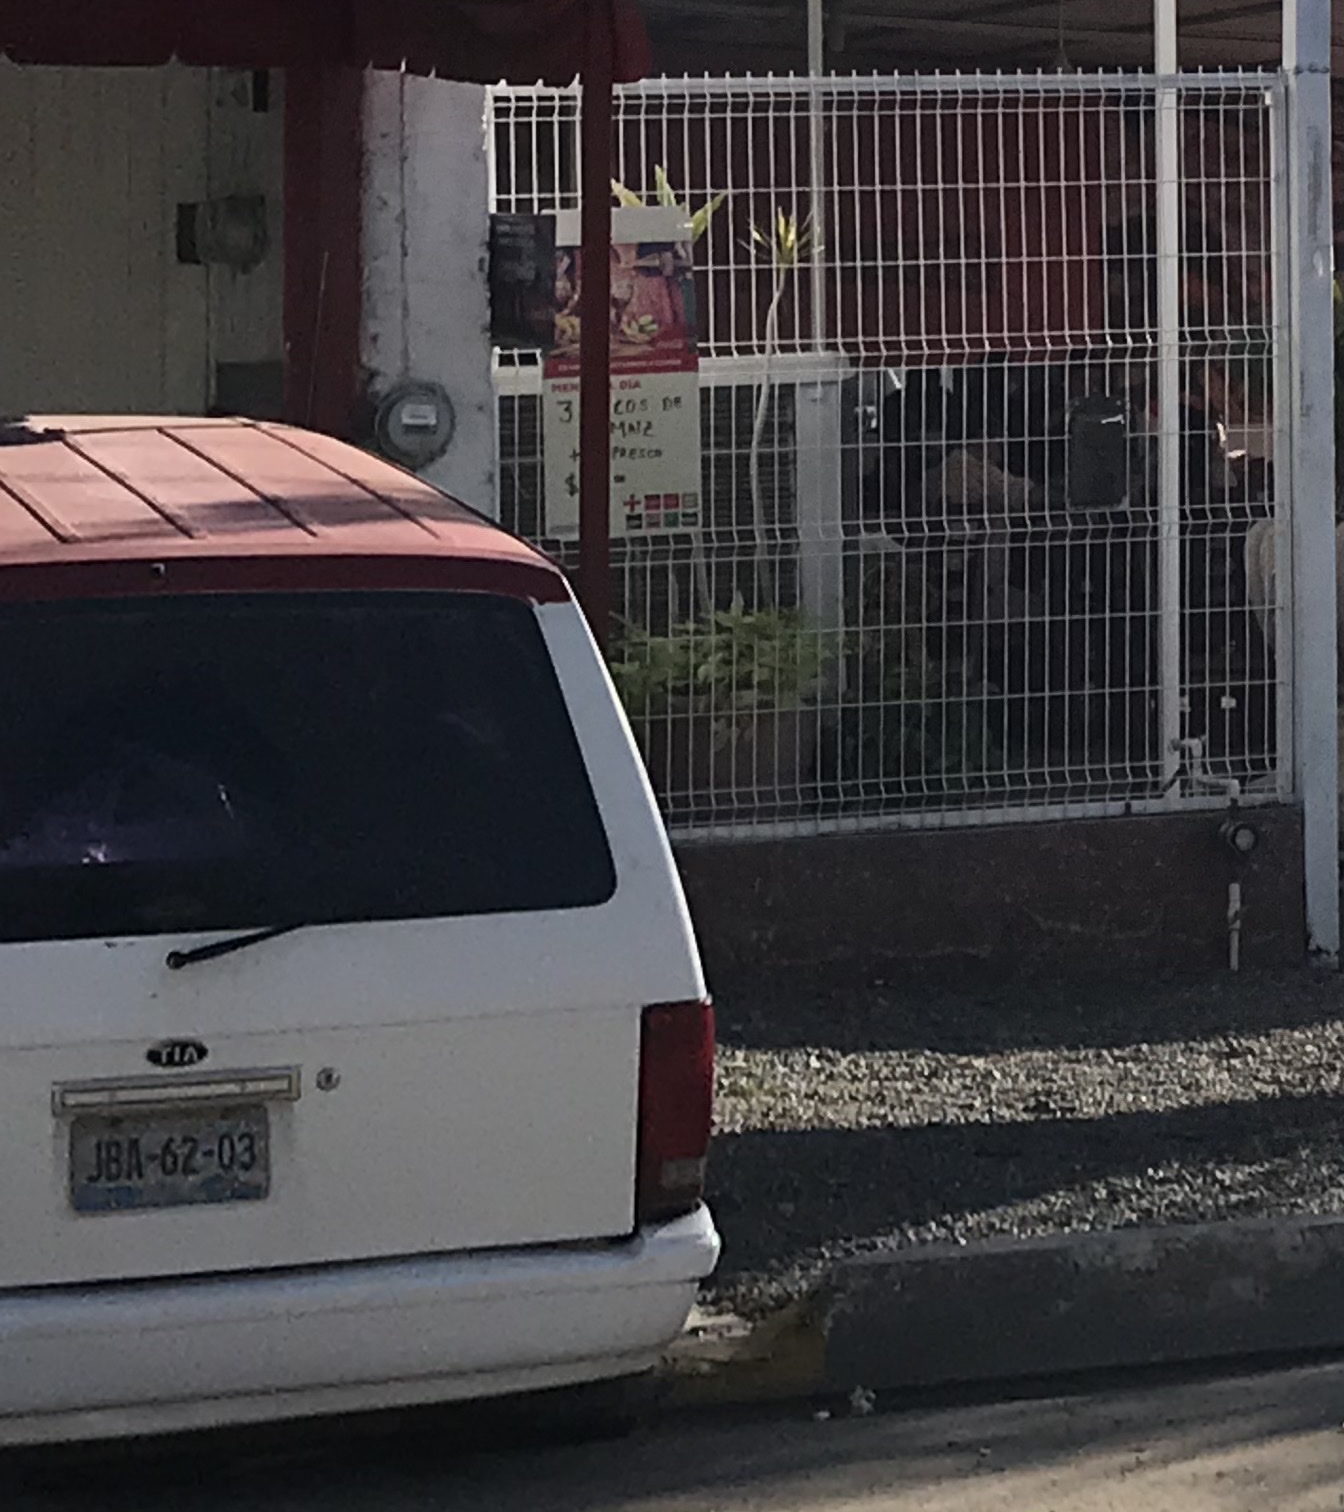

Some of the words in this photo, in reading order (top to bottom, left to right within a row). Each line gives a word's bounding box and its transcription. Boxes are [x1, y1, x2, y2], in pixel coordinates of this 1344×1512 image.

[556, 400, 573, 423] 3
[613, 398, 649, 415] COS
[86, 1132, 257, 1183] JBA-62-03
